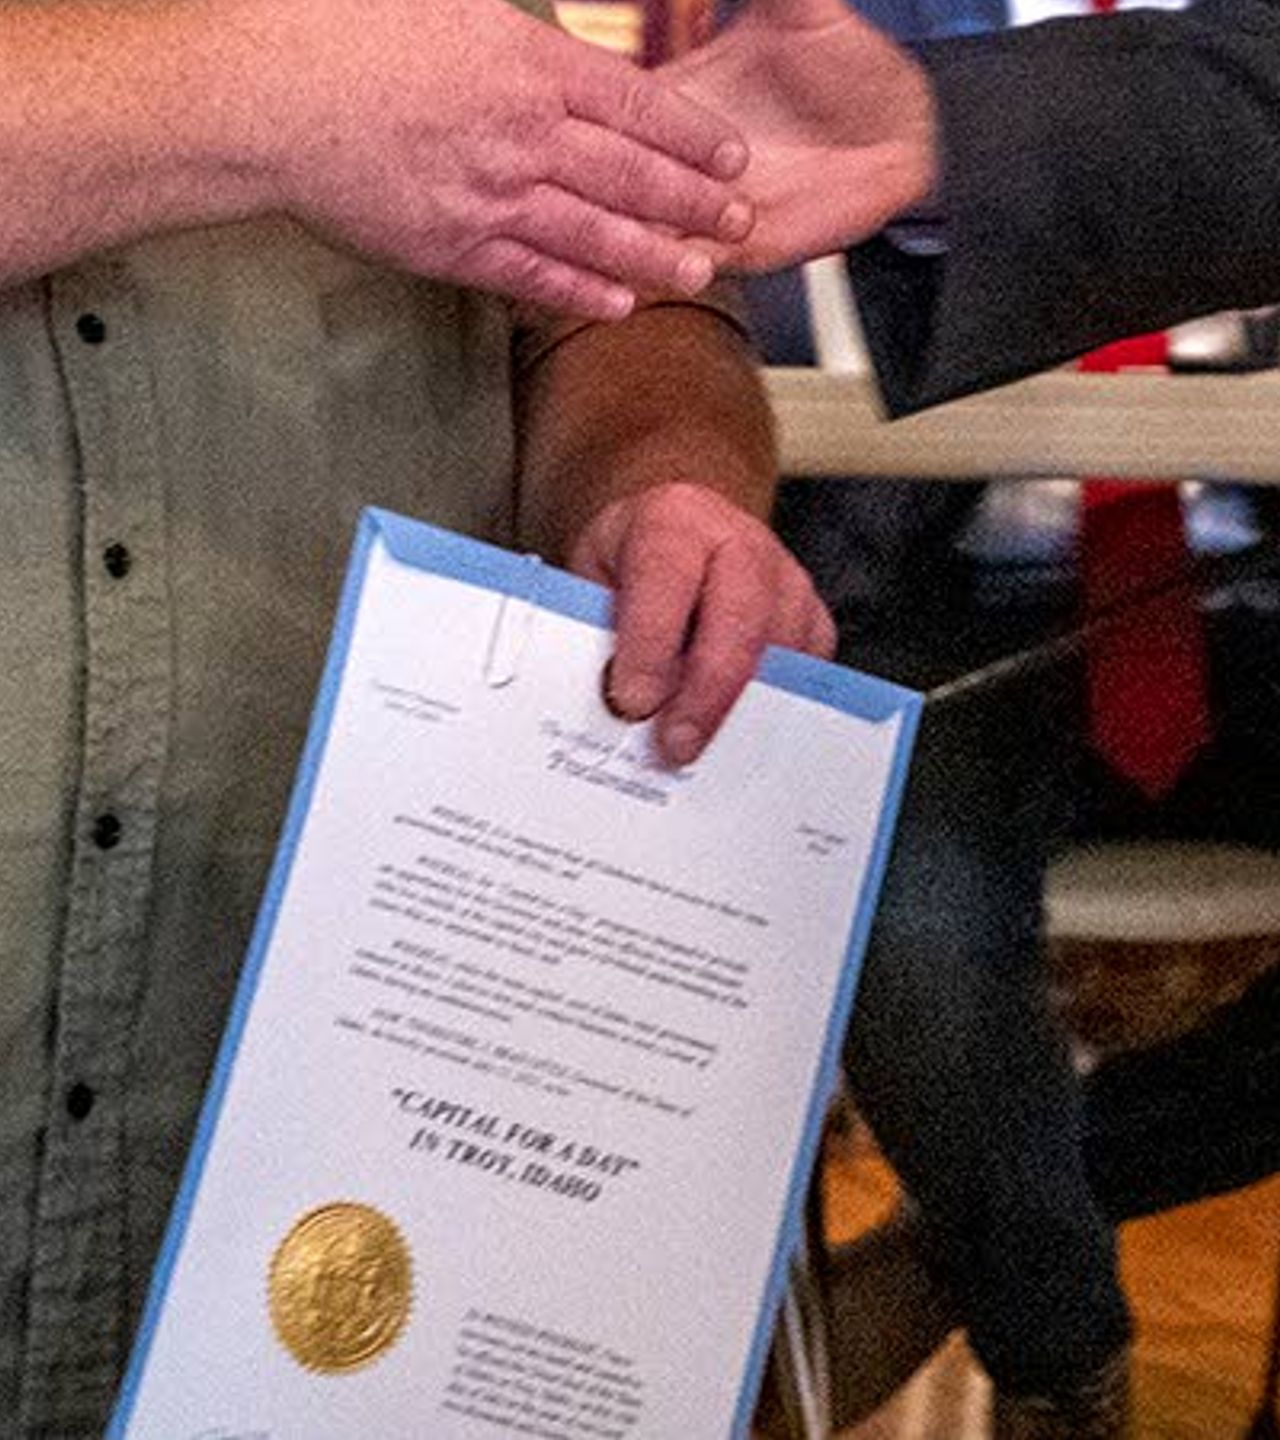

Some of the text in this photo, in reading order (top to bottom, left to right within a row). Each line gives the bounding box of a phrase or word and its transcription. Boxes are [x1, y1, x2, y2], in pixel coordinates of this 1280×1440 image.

[409, 1129, 440, 1152] IN
[519, 1162, 603, 1202] IDAHO
[503, 1123, 558, 1155] FOR
[557, 1142, 574, 1162] A
